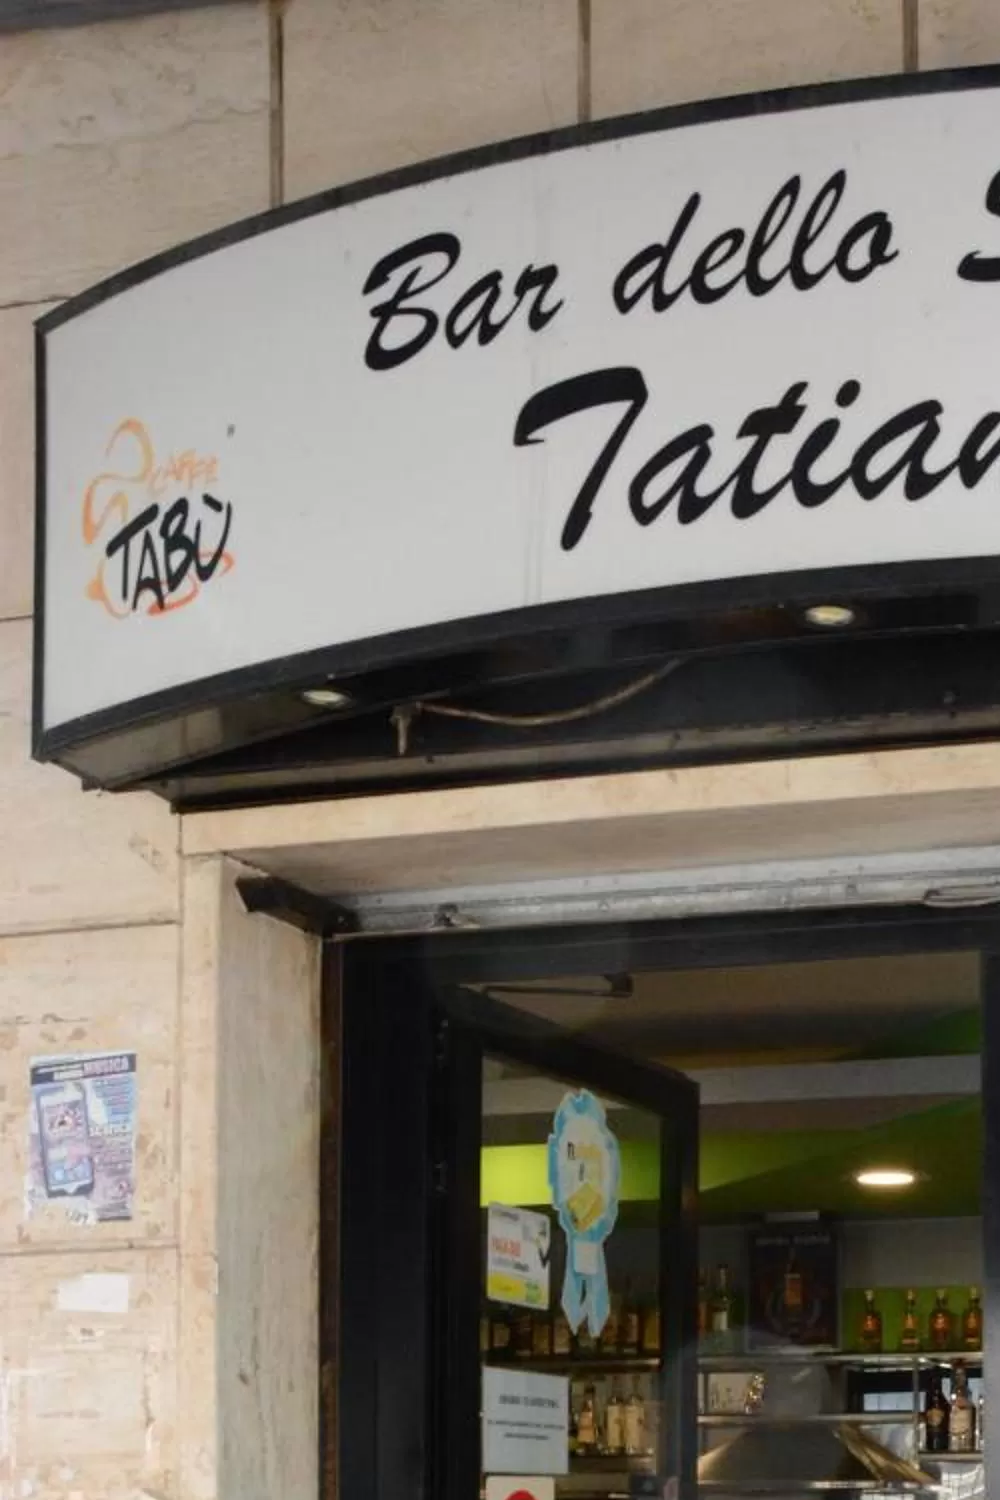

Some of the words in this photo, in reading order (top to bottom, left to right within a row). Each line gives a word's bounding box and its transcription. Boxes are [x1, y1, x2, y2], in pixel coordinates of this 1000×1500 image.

[362, 231, 564, 371] Bar
[612, 169, 900, 314] dello
[105, 492, 233, 612] TABÙ
